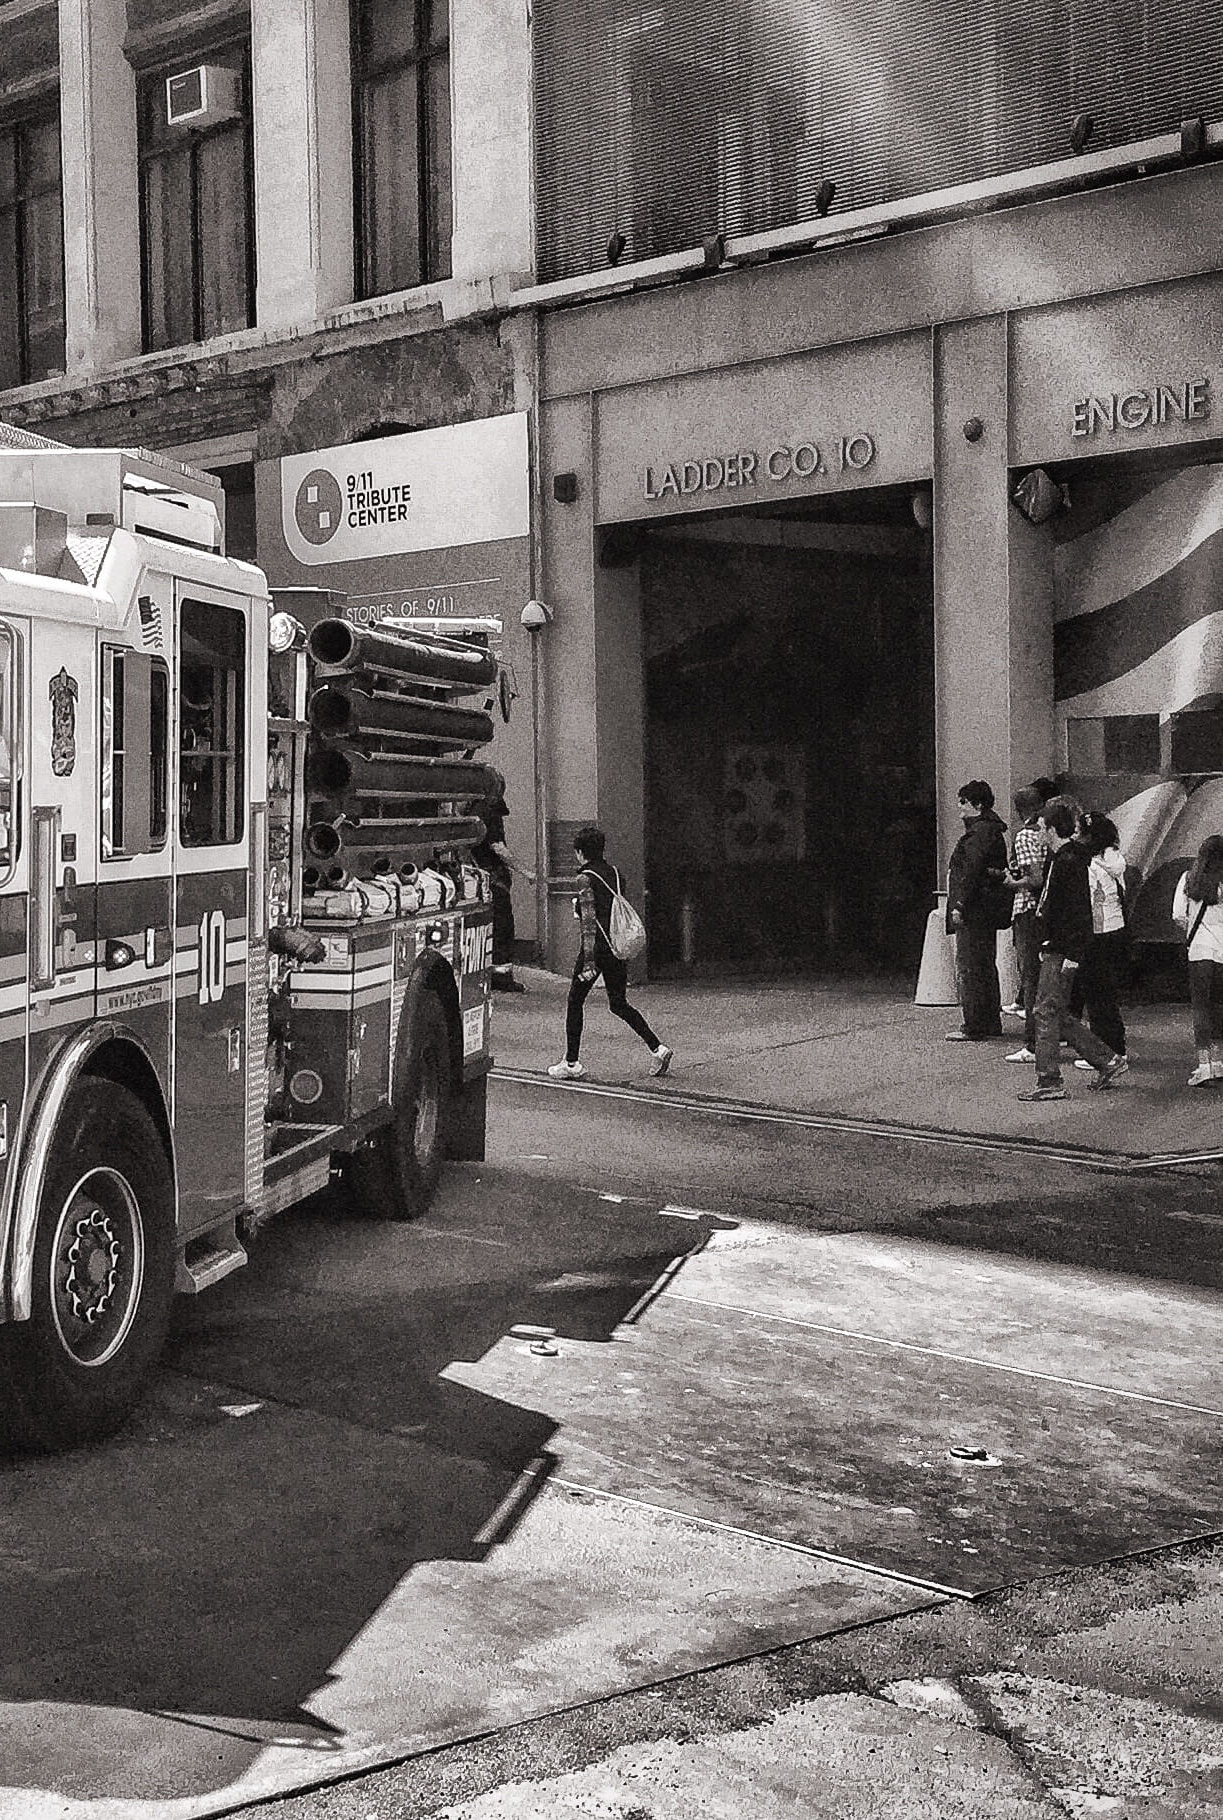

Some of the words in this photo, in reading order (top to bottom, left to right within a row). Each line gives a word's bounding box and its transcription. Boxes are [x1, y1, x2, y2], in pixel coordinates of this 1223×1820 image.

[1072, 379, 1210, 435] ENGINE
[644, 452, 759, 499] LADDER
[768, 442, 825, 481] CO.
[838, 433, 877, 473] 10
[346, 471, 373, 493] 9/11
[347, 484, 411, 510] TRIBUTE
[348, 503, 408, 528] CENTER
[346, 604, 394, 623] STORIES
[401, 600, 419, 617] OF
[427, 596, 454, 615] 9/11
[199, 910, 225, 1005] 10
